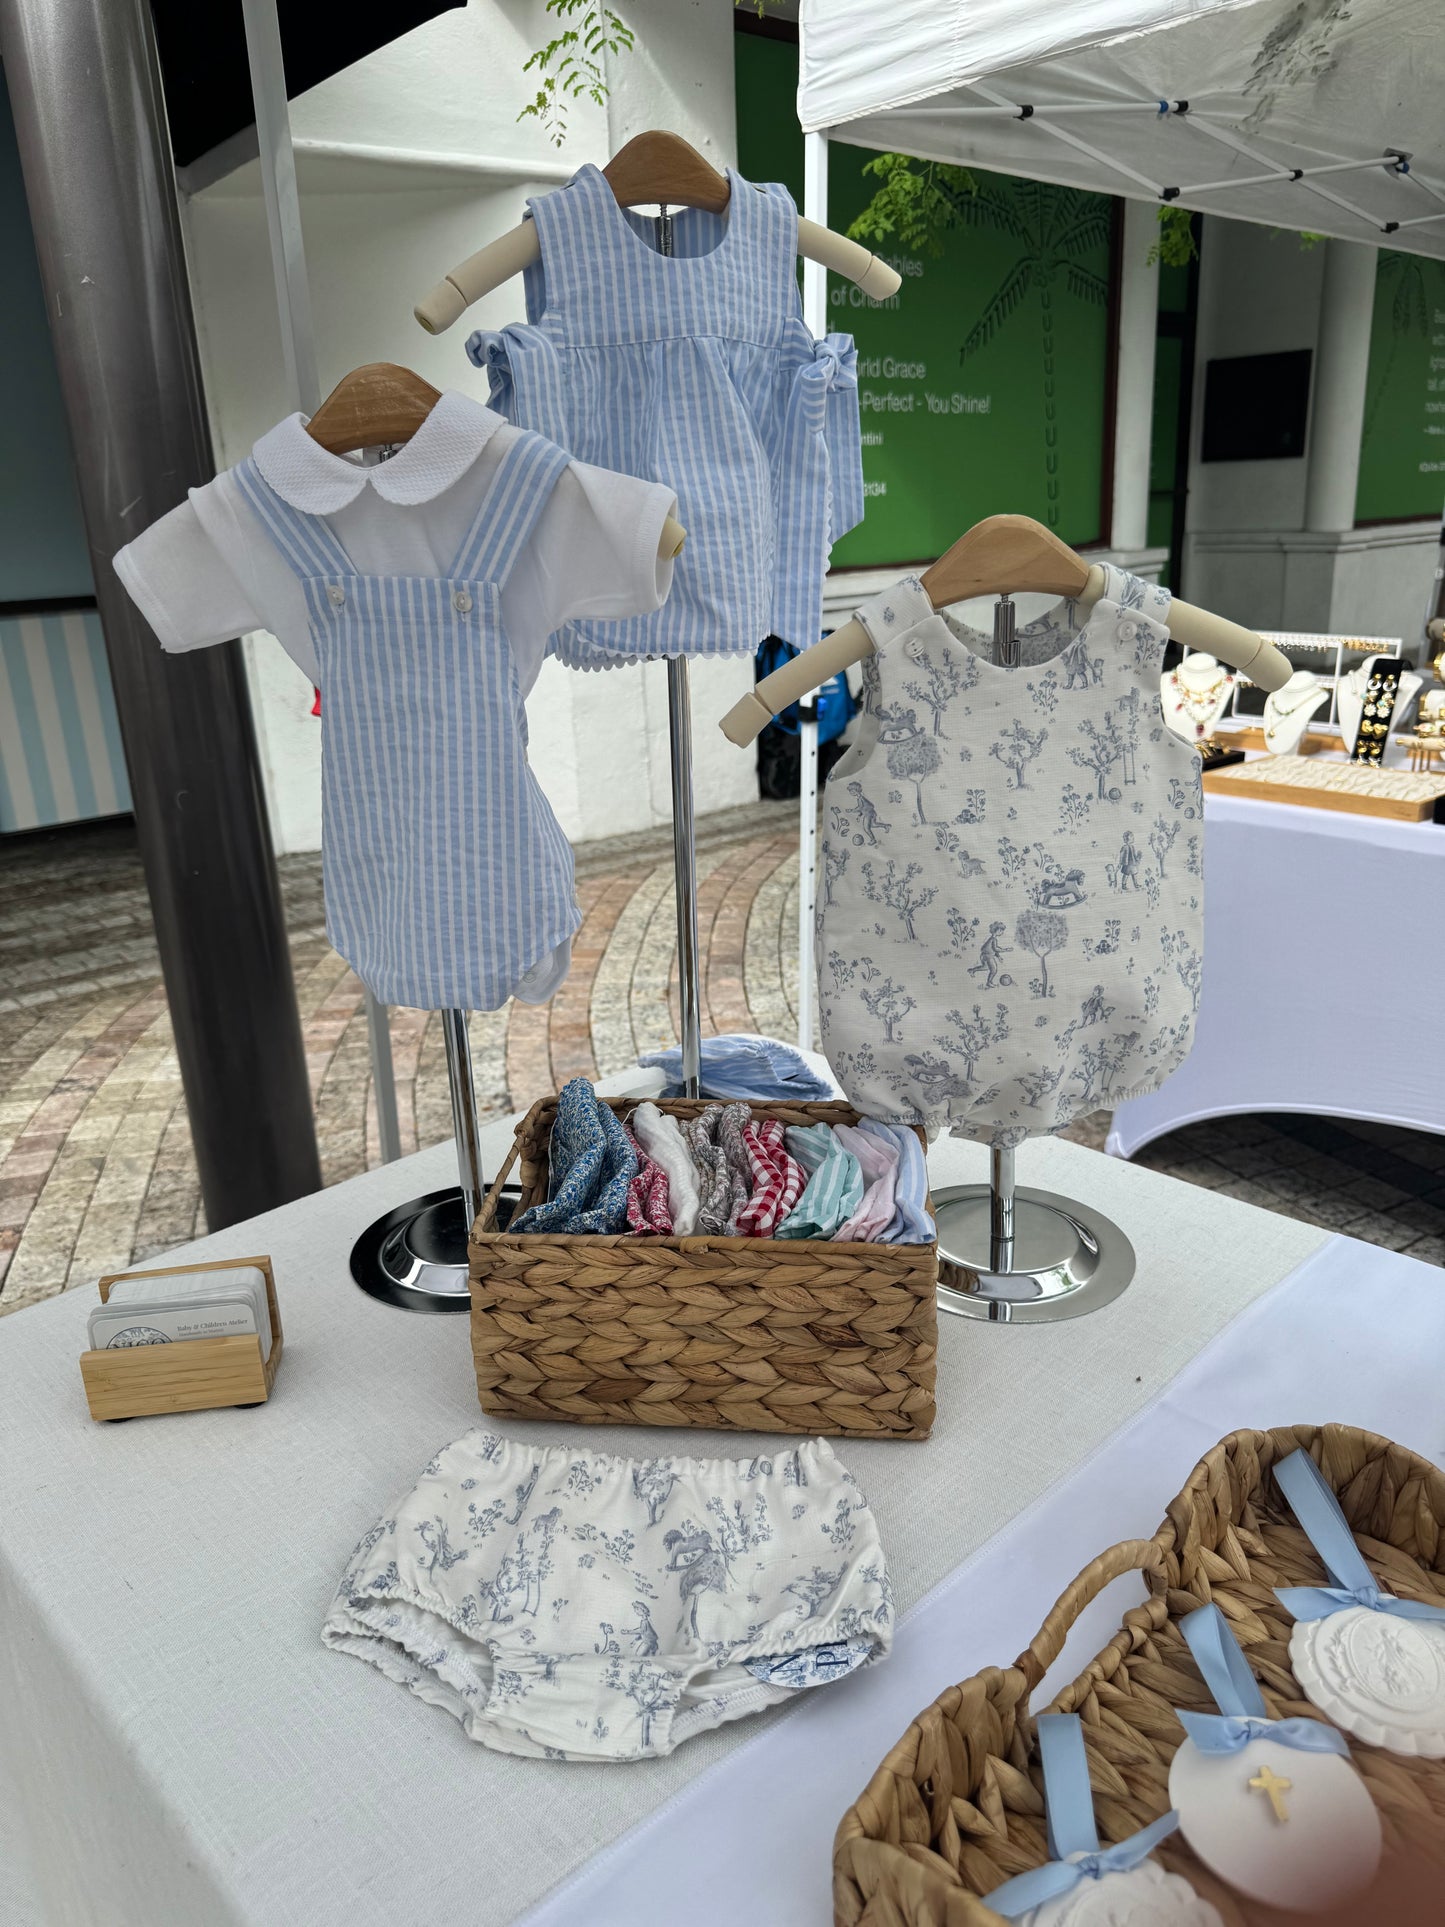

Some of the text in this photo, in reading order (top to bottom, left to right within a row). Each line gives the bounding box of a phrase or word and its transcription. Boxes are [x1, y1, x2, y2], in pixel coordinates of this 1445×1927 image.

[830, 285, 847, 306] of
[882, 357, 927, 379] Grace
[924, 391, 949, 414] You
[951, 392, 991, 414] Shine!
[200, 1321, 227, 1329] Children
